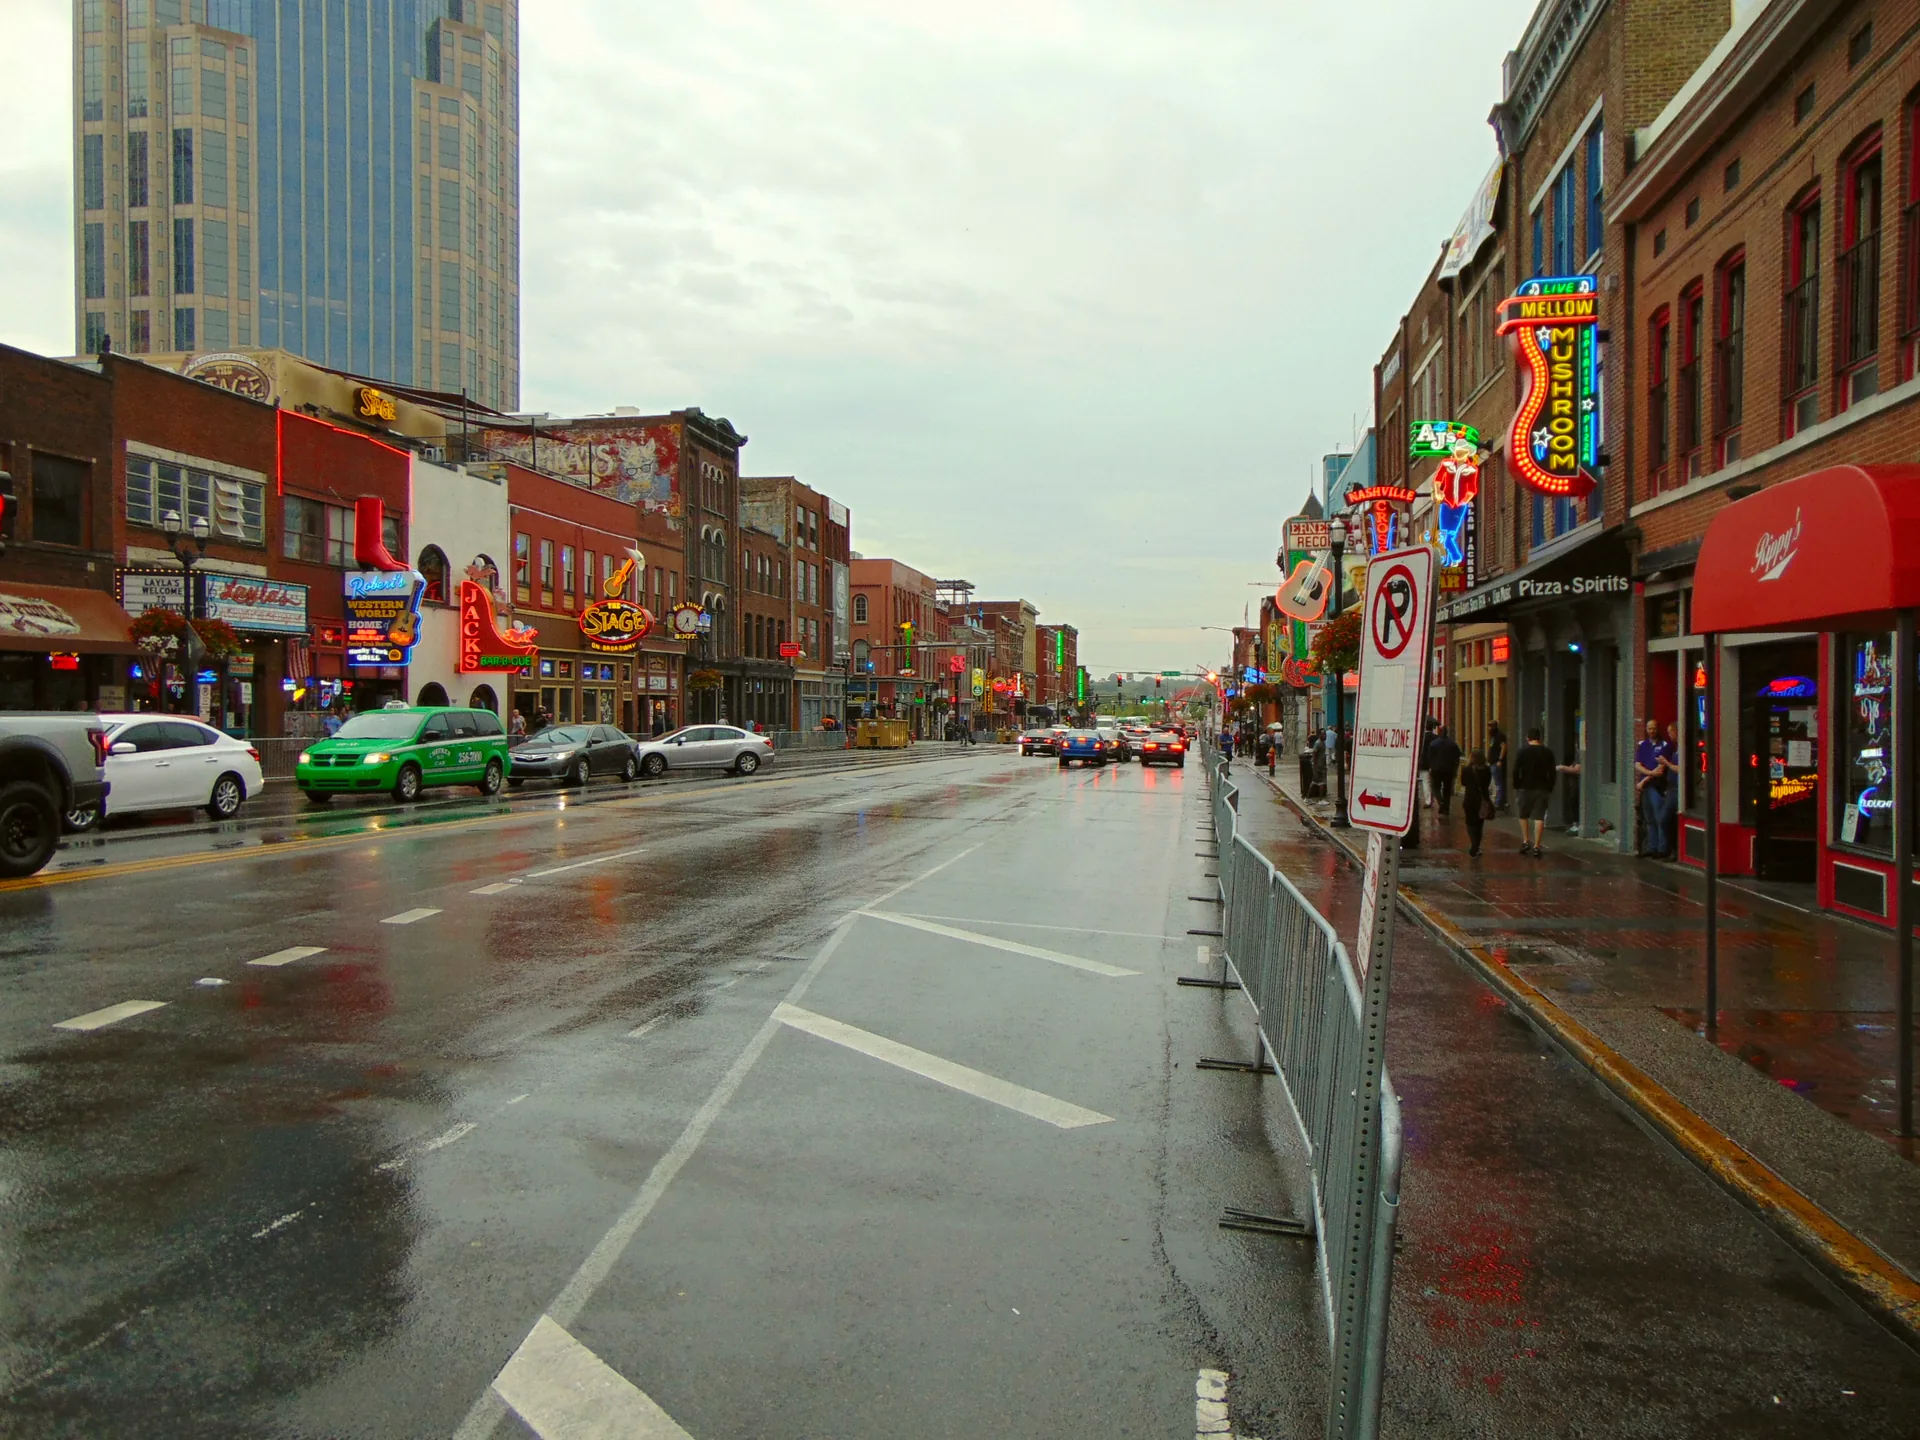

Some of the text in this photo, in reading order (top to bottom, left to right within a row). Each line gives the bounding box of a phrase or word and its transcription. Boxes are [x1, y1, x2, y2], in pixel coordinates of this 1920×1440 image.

[1543, 282, 1574, 293] LIVE
[1521, 299, 1593, 317] MELLOW
[215, 366, 232, 375] THE
[360, 388, 396, 420] STAGE
[1550, 327, 1575, 470] MUSHROOM
[1582, 414, 1590, 461] PIZZA
[1348, 486, 1415, 502] NASHVILLE
[1467, 501, 1475, 588] ALAN JACKSON
[1750, 506, 1801, 574] Rippy's
[144, 579, 179, 587] LAYLA'S
[349, 573, 406, 600] Robert's
[1519, 575, 1629, 596] Pizza Spirits
[347, 600, 404, 609] WESTERN
[355, 609, 396, 618] WORLD
[673, 601, 704, 611] BIG TIME
[348, 620, 382, 629] HOME
[464, 588, 481, 668] JACKS
[584, 607, 646, 635] STAGE
[602, 642, 636, 651] BROADWAY
[481, 656, 531, 666] BAR-B-QUE
[1359, 728, 1410, 748] LOADING ZONE
